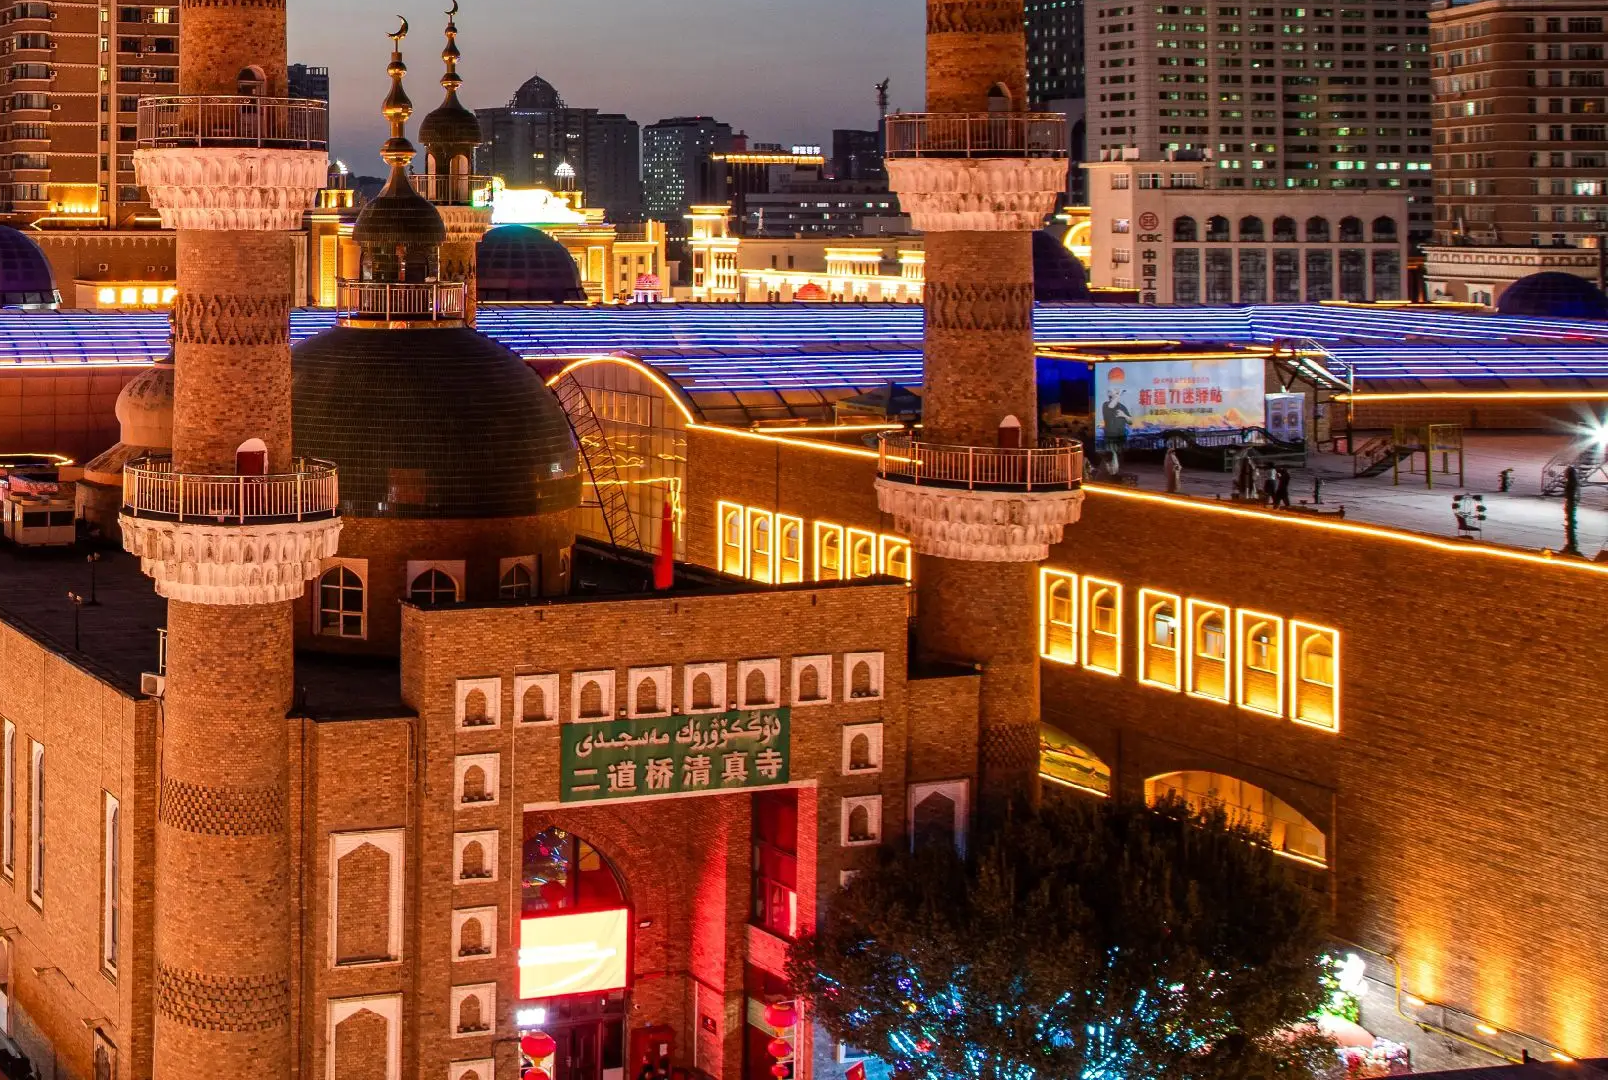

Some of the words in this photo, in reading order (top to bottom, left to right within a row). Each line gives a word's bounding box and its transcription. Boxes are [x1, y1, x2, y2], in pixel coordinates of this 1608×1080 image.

[1137, 233, 1163, 243] ICBC
[571, 748, 783, 793] 二道桥清真寺
